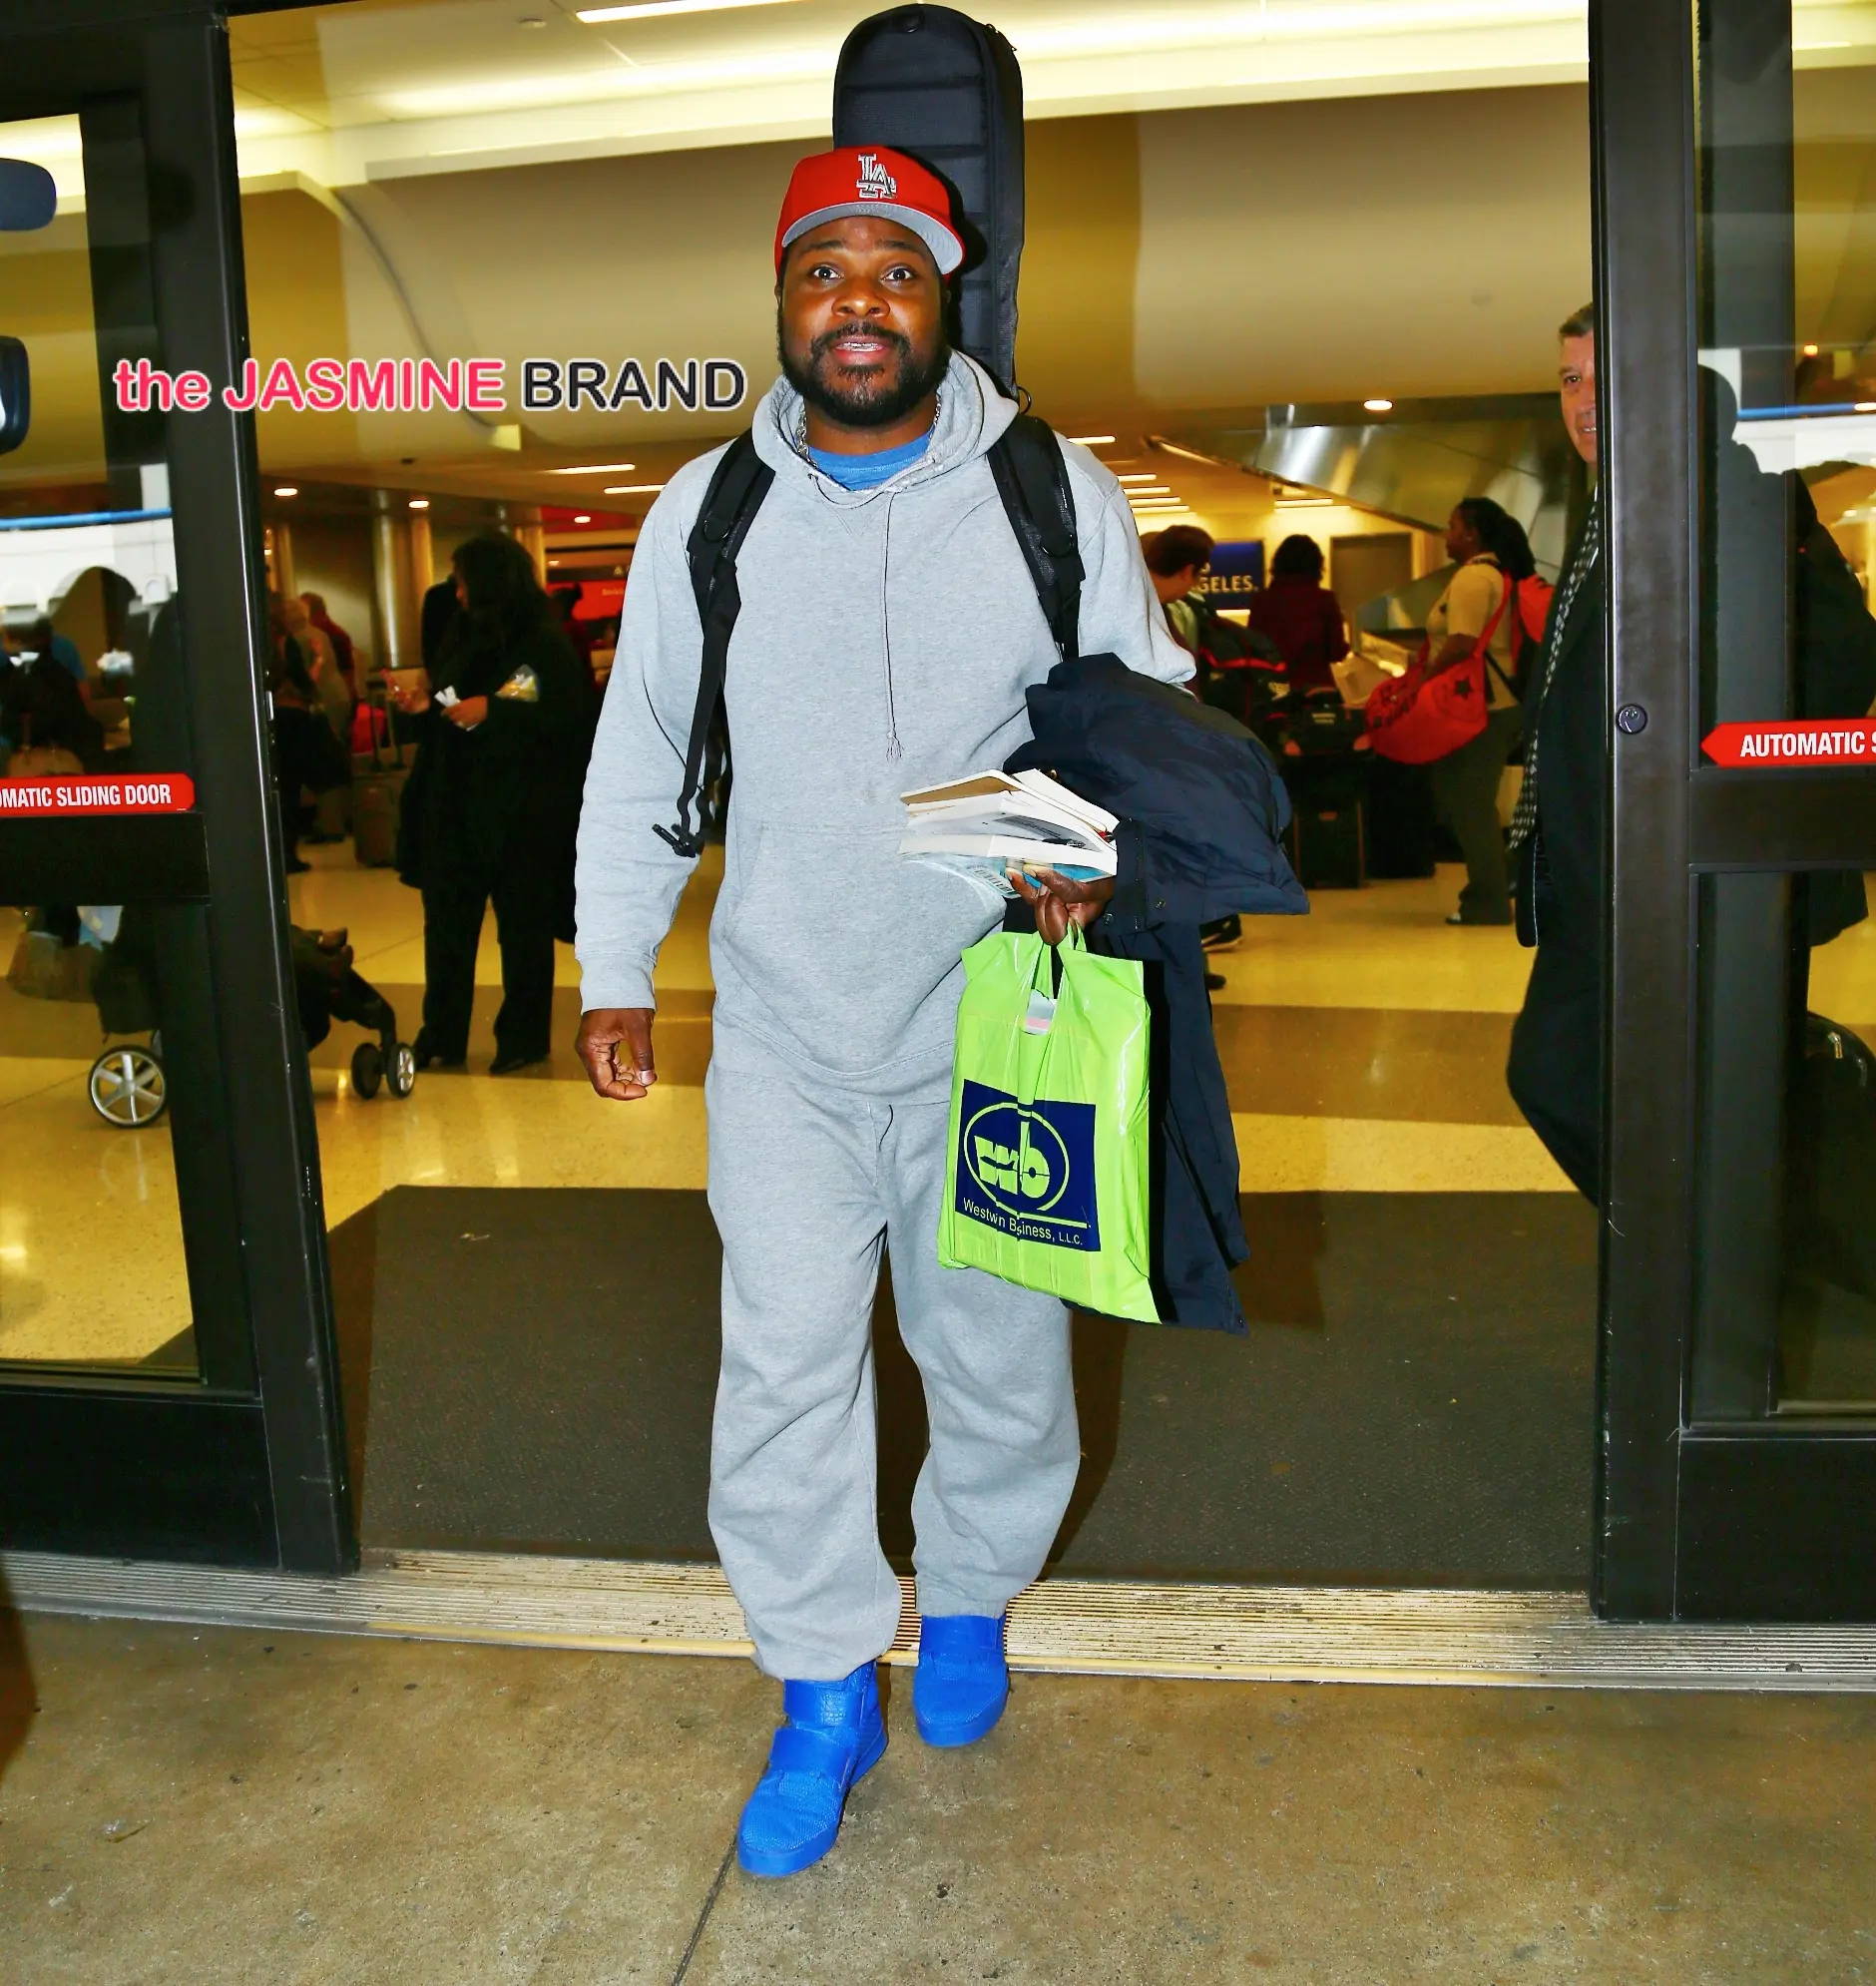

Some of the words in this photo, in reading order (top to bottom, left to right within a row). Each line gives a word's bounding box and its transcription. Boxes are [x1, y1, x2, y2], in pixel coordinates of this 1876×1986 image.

[856, 153, 897, 200] LA
[1193, 574, 1259, 595] GELES.
[1740, 731, 1865, 758] AUTOMATIC
[56, 784, 121, 806] SLIDING
[125, 783, 172, 805] DOOR
[963, 1197, 1005, 1229] Westwin
[1009, 1217, 1056, 1242] Bsiness,
[1059, 1231, 1084, 1245] L.L.C.
